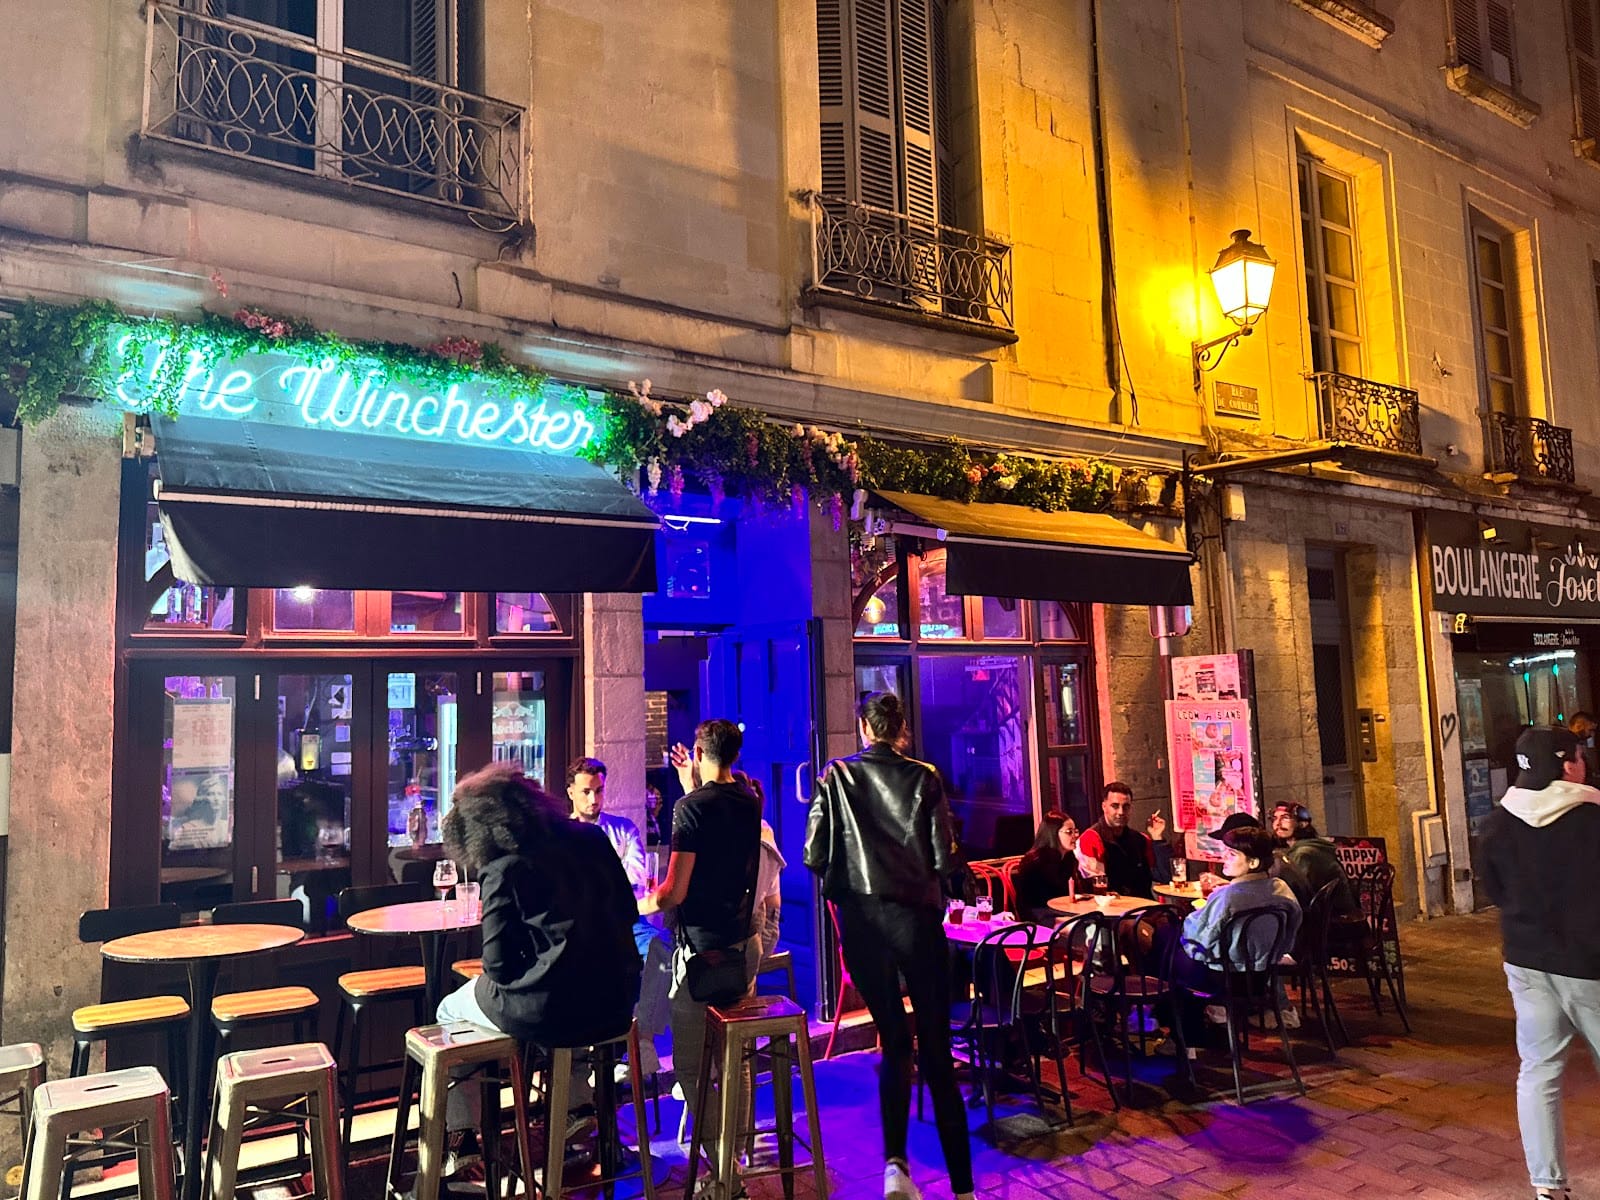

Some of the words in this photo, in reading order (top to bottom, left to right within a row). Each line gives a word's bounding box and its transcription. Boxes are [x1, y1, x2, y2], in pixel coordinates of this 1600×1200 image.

[116, 334, 259, 414] The
[279, 356, 595, 450] Winchester
[1432, 545, 1542, 600] BOULANGERIE
